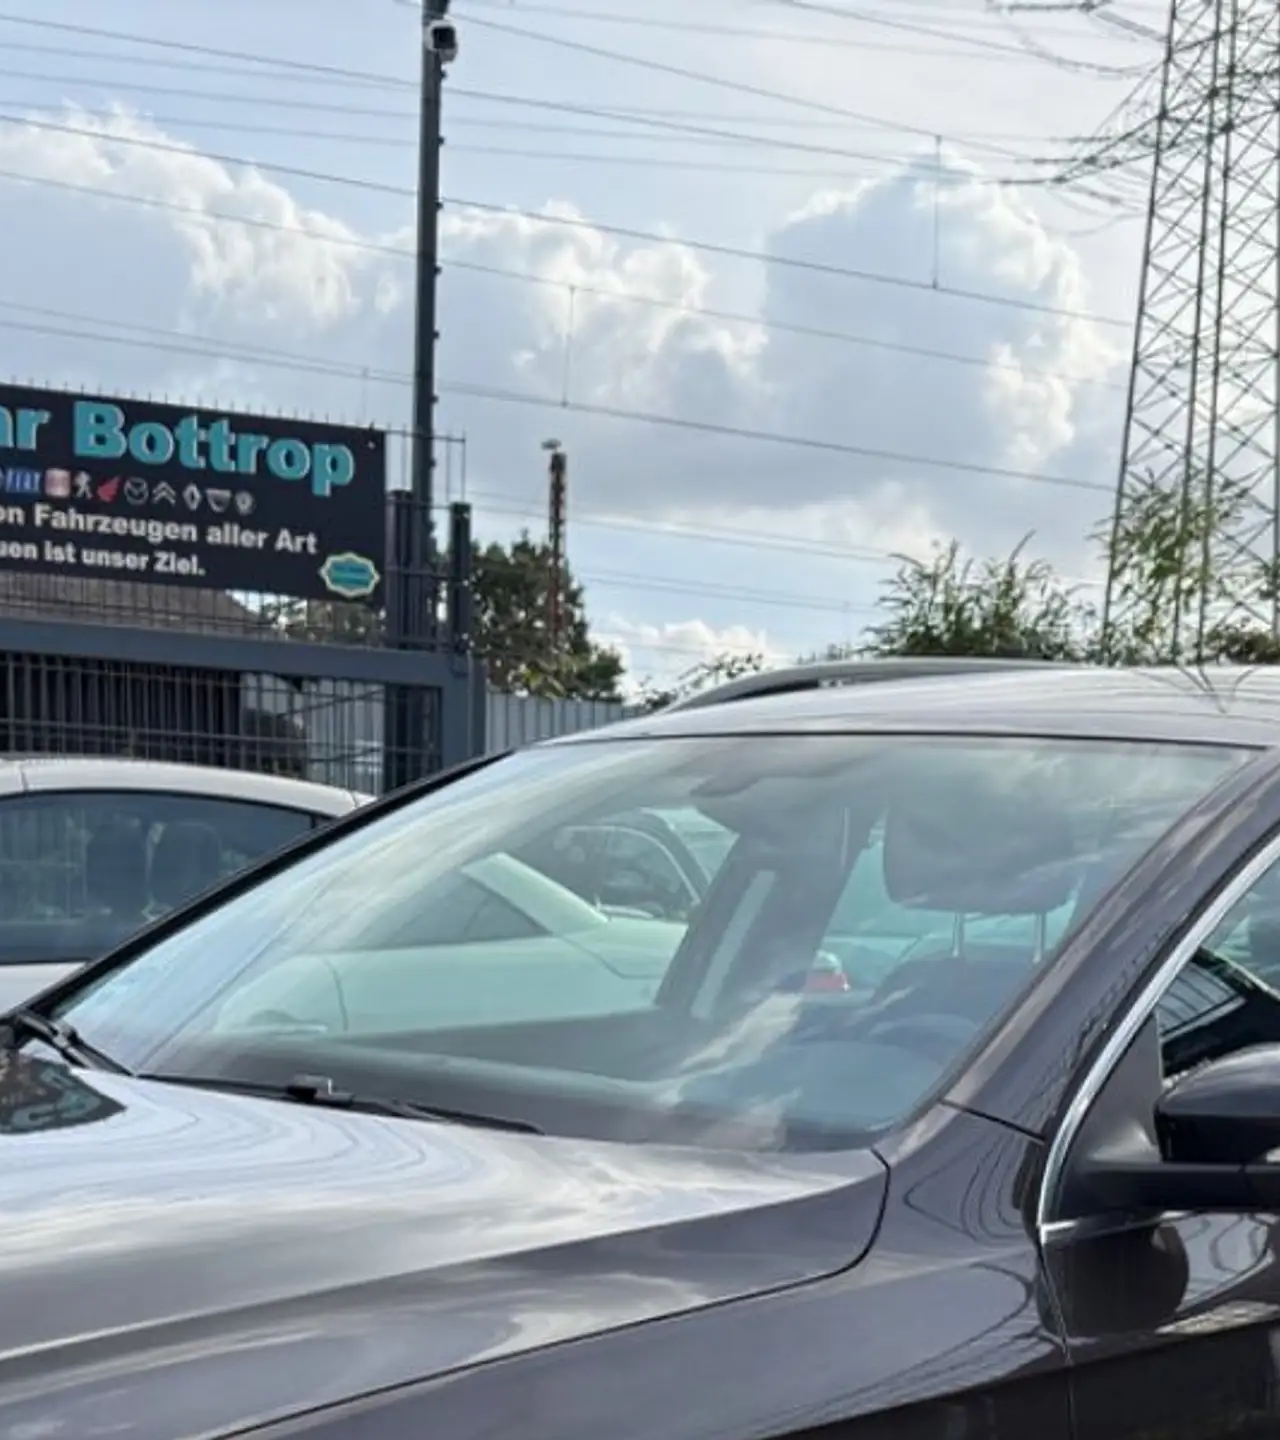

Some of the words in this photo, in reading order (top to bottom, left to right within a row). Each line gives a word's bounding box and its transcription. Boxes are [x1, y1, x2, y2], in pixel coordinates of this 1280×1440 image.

[74, 401, 355, 497] Bottrop
[34, 503, 198, 545] Fahrzeugen
[206, 523, 270, 550] aller
[274, 528, 318, 555] Art
[81, 550, 150, 571] unser
[154, 551, 206, 576] Ziel.
